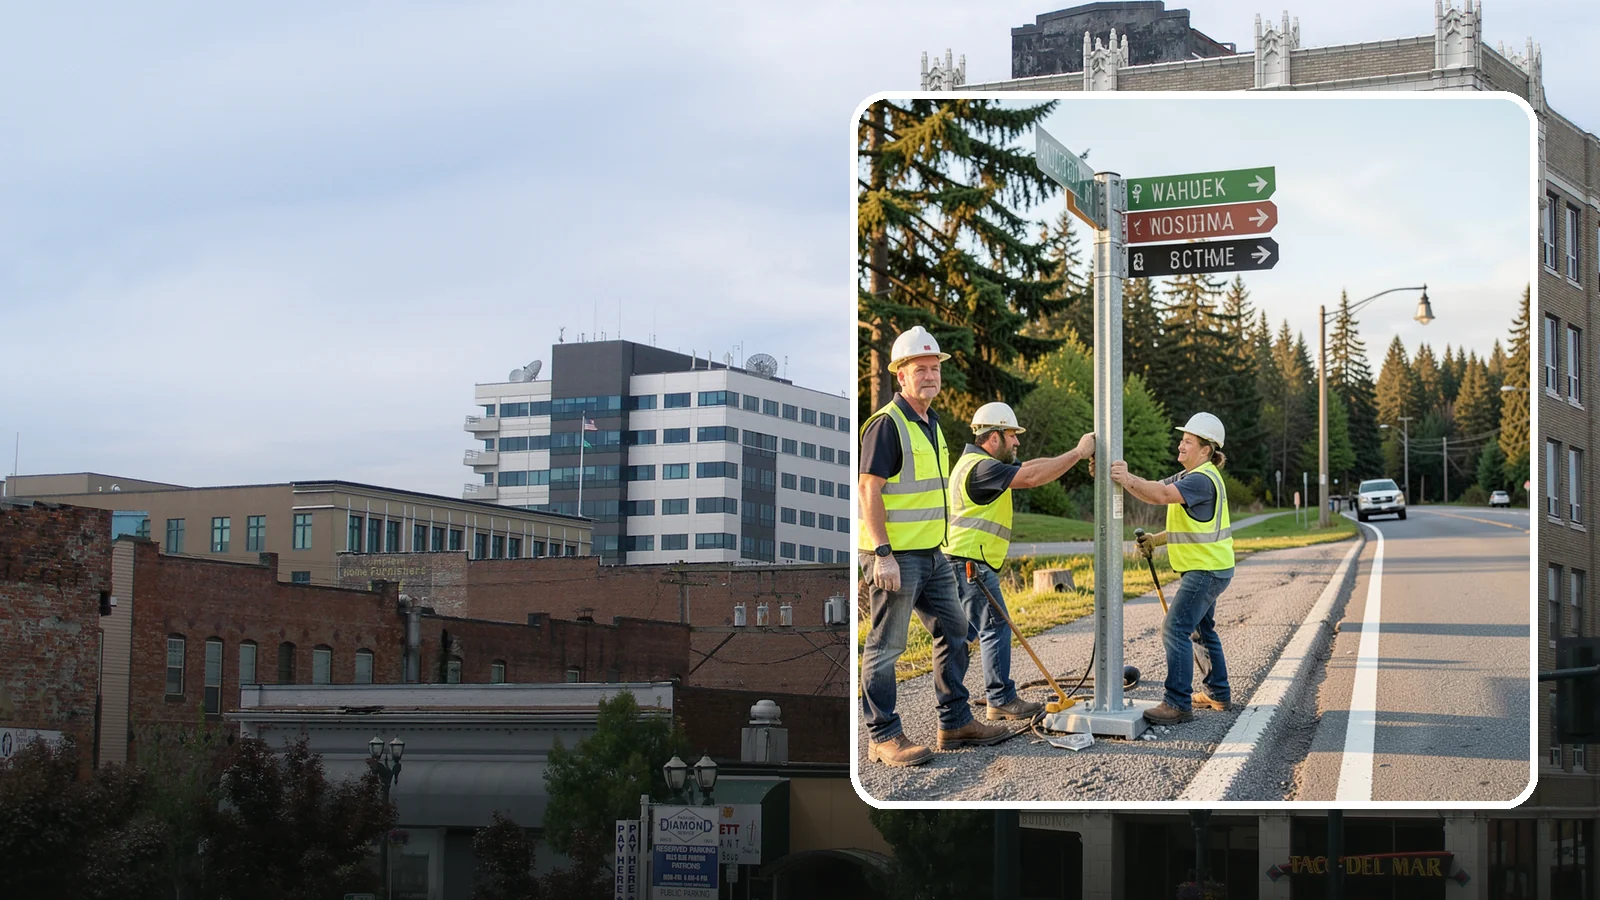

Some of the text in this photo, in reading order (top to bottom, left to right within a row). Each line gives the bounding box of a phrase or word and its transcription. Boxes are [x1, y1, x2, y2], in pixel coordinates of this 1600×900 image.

[370, 566, 427, 576] Furnishers
[660, 818, 713, 833] DIAMOND
[1022, 815, 1069, 828] BUILDING
[656, 845, 716, 854] RESERVED PARKING
[616, 825, 625, 893] PAY HERE
[627, 824, 637, 893] PAY HERE
[721, 851, 739, 862] Soup
[671, 862, 701, 870] PATRONS
[1290, 855, 1443, 877] TAC DEL MAR
[660, 888, 710, 898] PUBLIC PARKING
